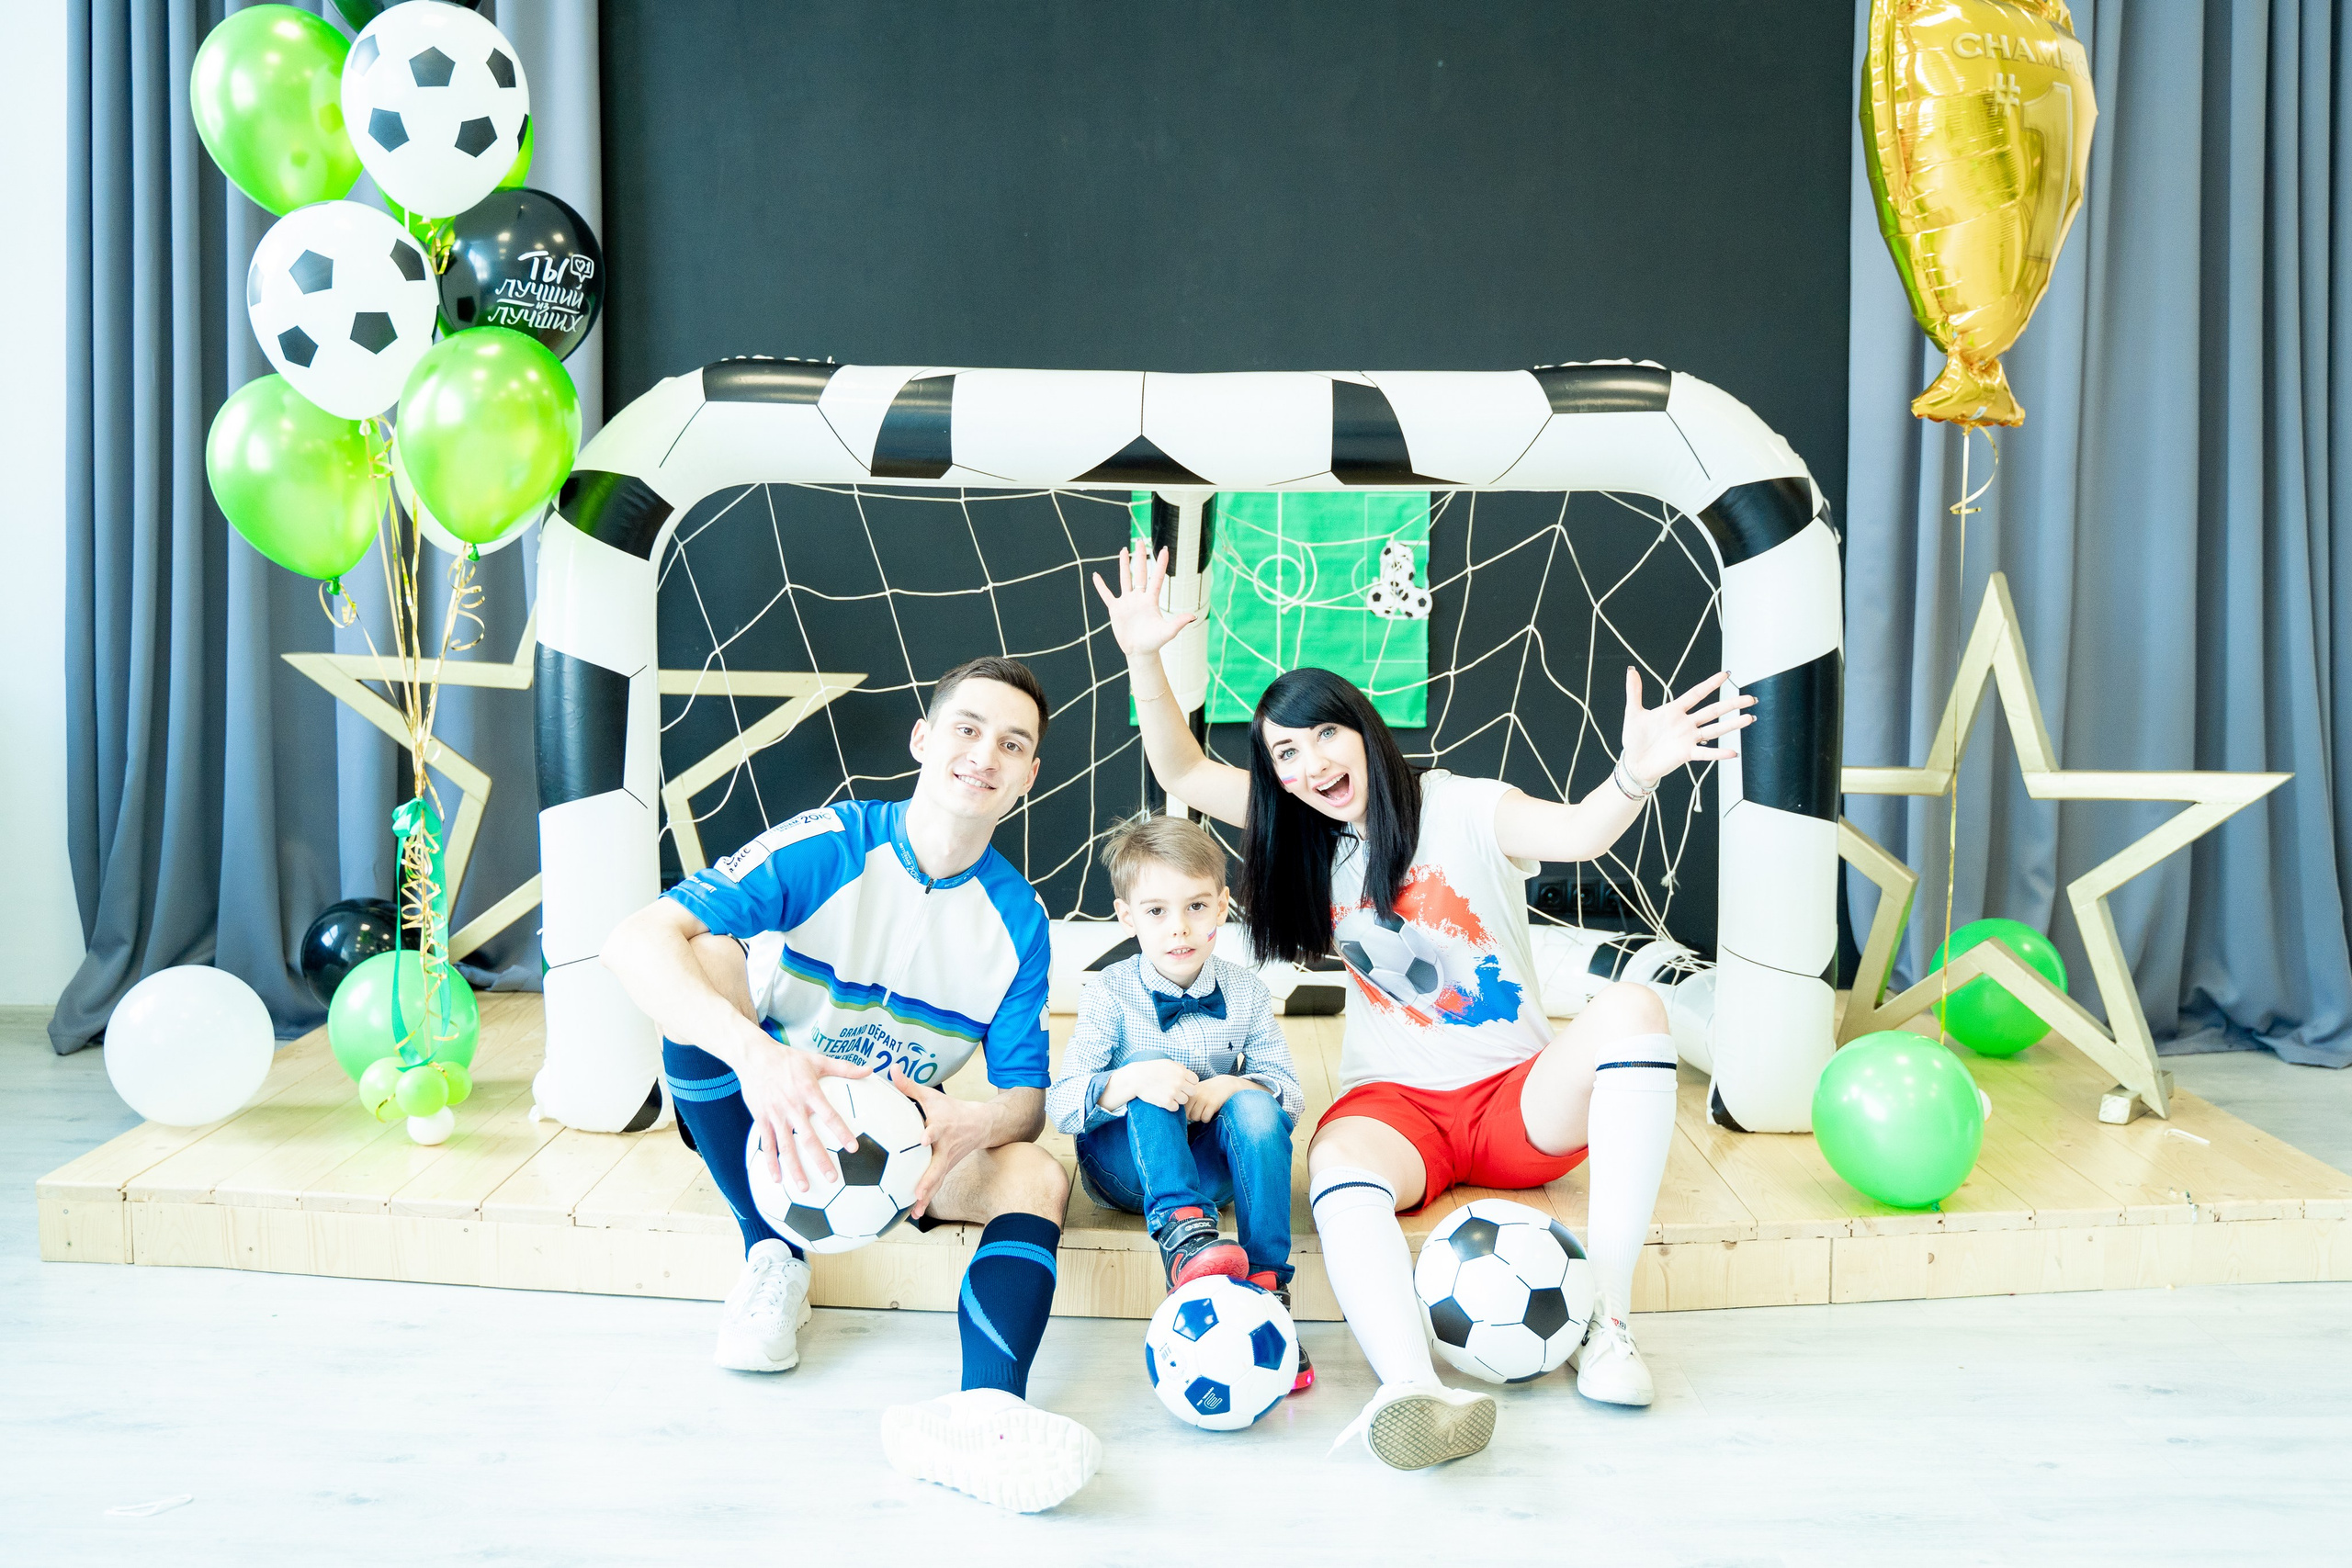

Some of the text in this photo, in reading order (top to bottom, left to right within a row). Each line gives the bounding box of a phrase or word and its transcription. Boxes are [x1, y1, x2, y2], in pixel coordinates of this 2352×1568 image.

[517, 250, 571, 285] ТЫ
[494, 278, 584, 310] ЛУЧШИЙ
[487, 306, 584, 333] ЛУЧШИХ
[800, 812, 831, 824] 2010
[811, 1021, 875, 1058] ROTTERDAM
[840, 1023, 903, 1053] GRAND DÉPART
